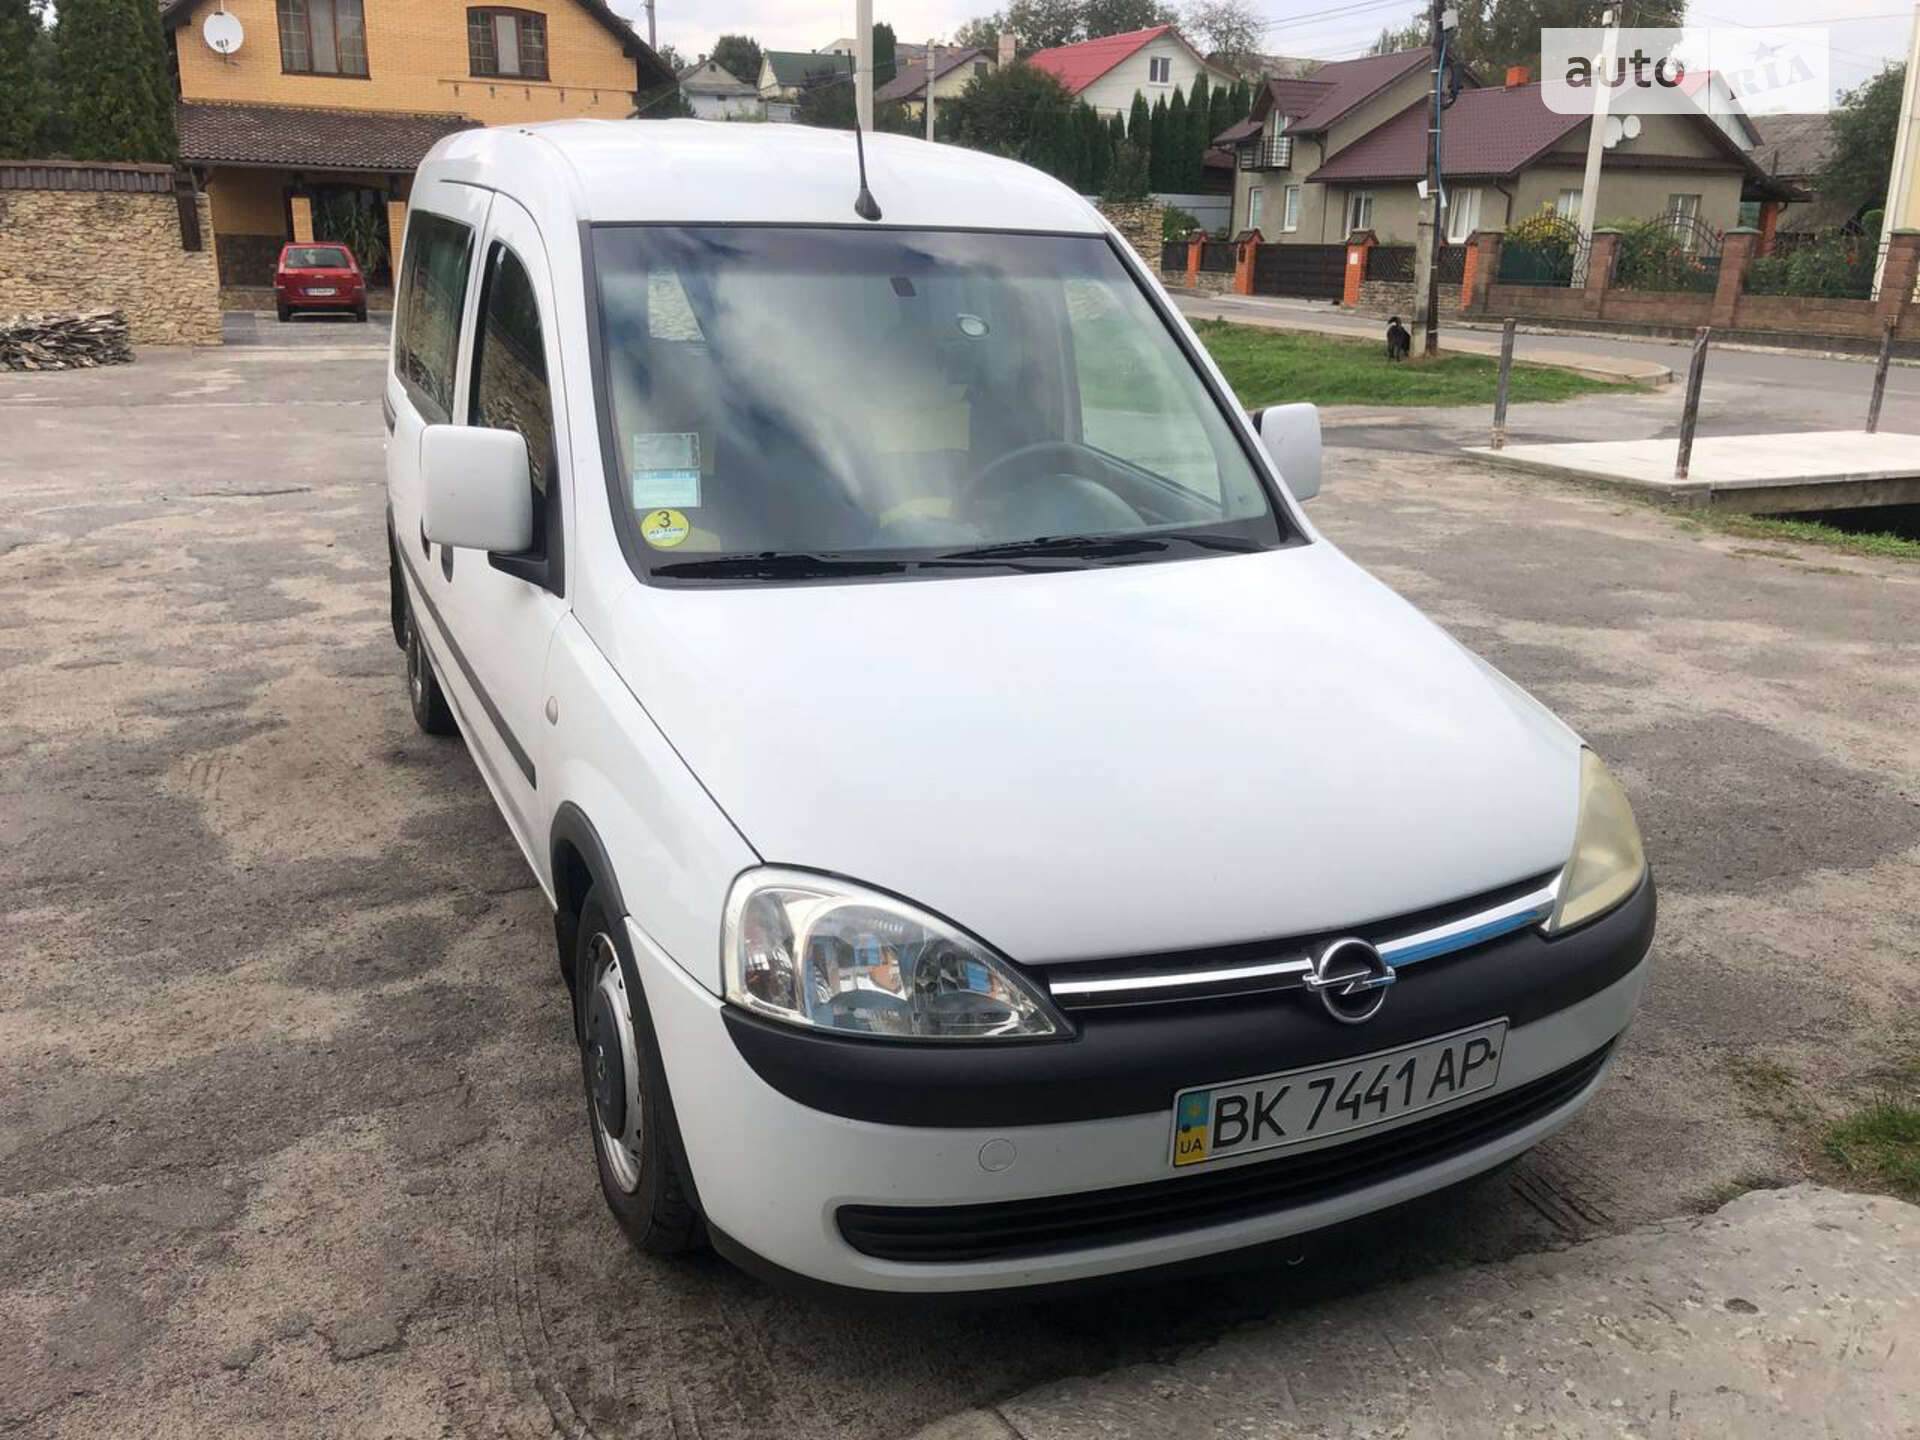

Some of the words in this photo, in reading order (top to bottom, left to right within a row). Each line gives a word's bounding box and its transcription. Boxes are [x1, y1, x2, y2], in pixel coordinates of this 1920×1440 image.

[657, 510, 671, 528] 3
[1212, 1085, 1291, 1149] BK
[1306, 1056, 1416, 1131] 7441
[1427, 1037, 1492, 1099] AP
[1180, 1137, 1202, 1154] UA
